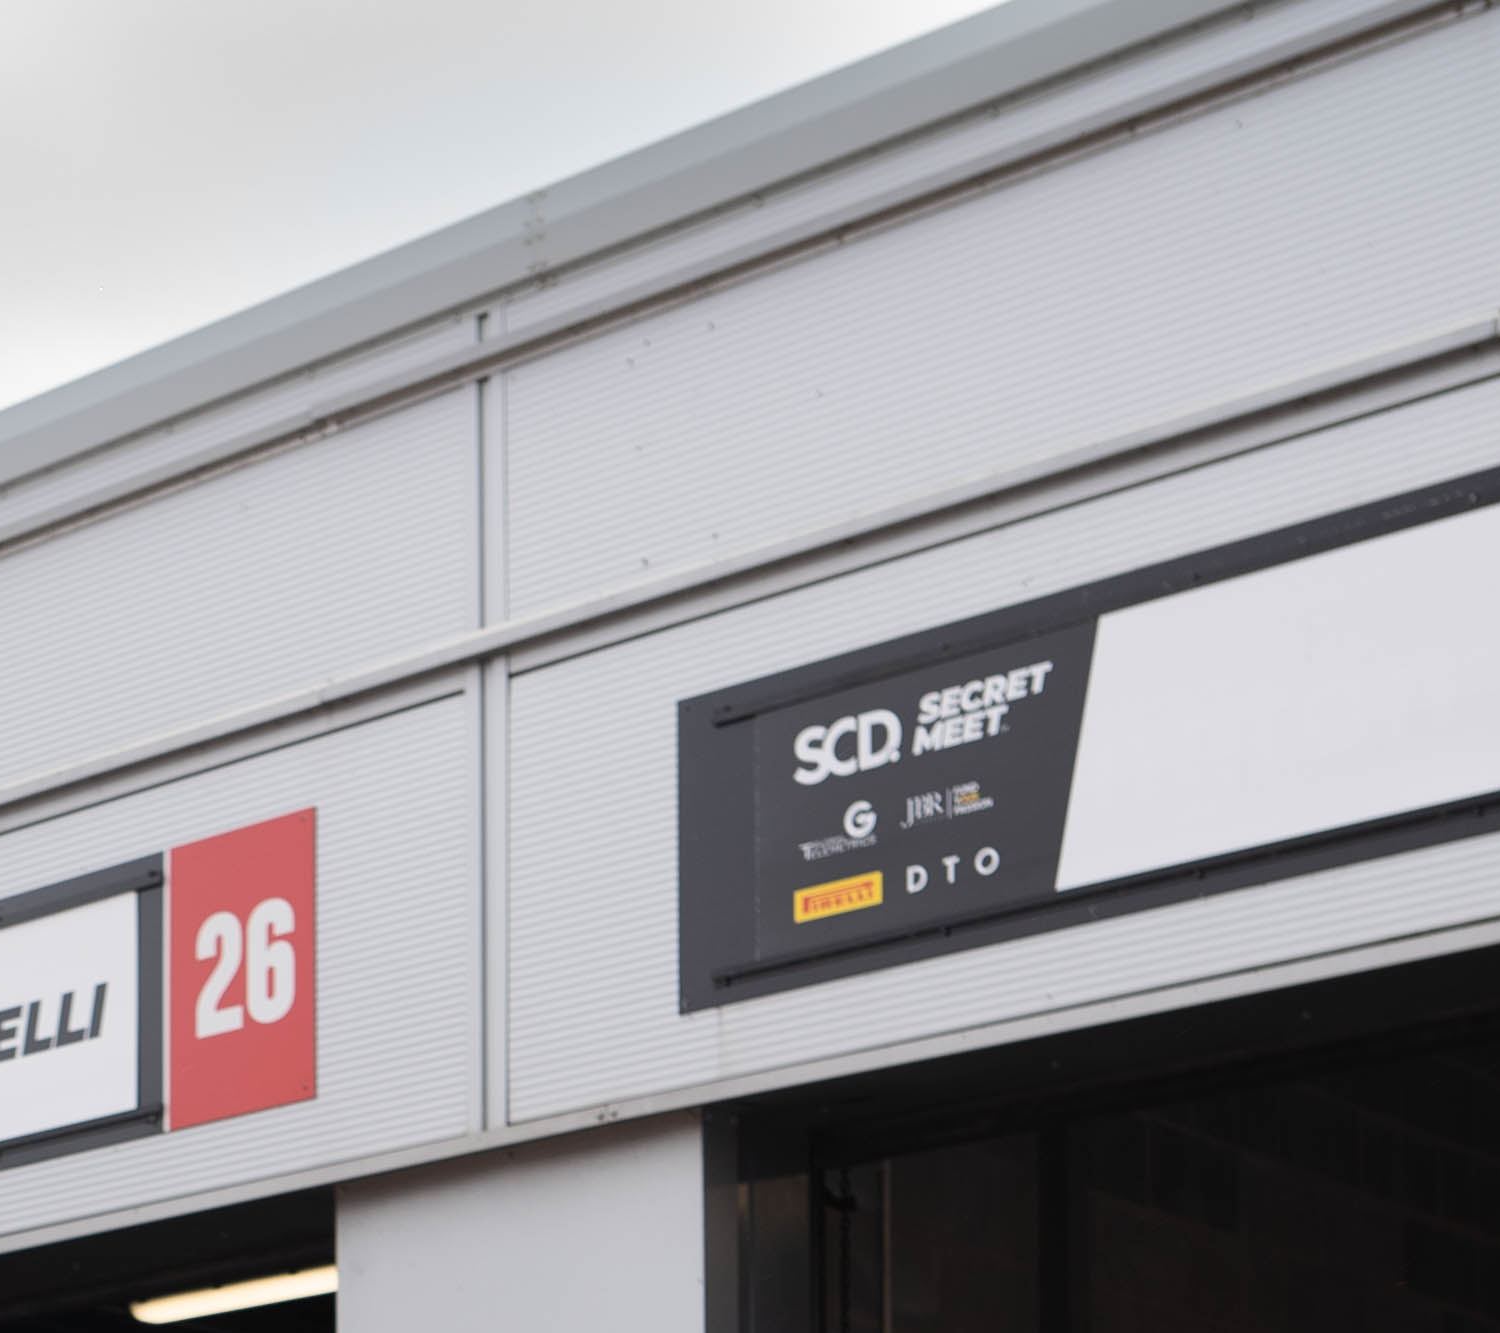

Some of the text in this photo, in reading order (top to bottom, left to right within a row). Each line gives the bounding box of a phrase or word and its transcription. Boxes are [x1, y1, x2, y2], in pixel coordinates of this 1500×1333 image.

[917, 660, 1053, 725] SECRET
[912, 704, 1009, 757] MEET
[843, 800, 878, 839] G
[803, 880, 874, 915] PIRELLI
[193, 897, 297, 1040] 26
